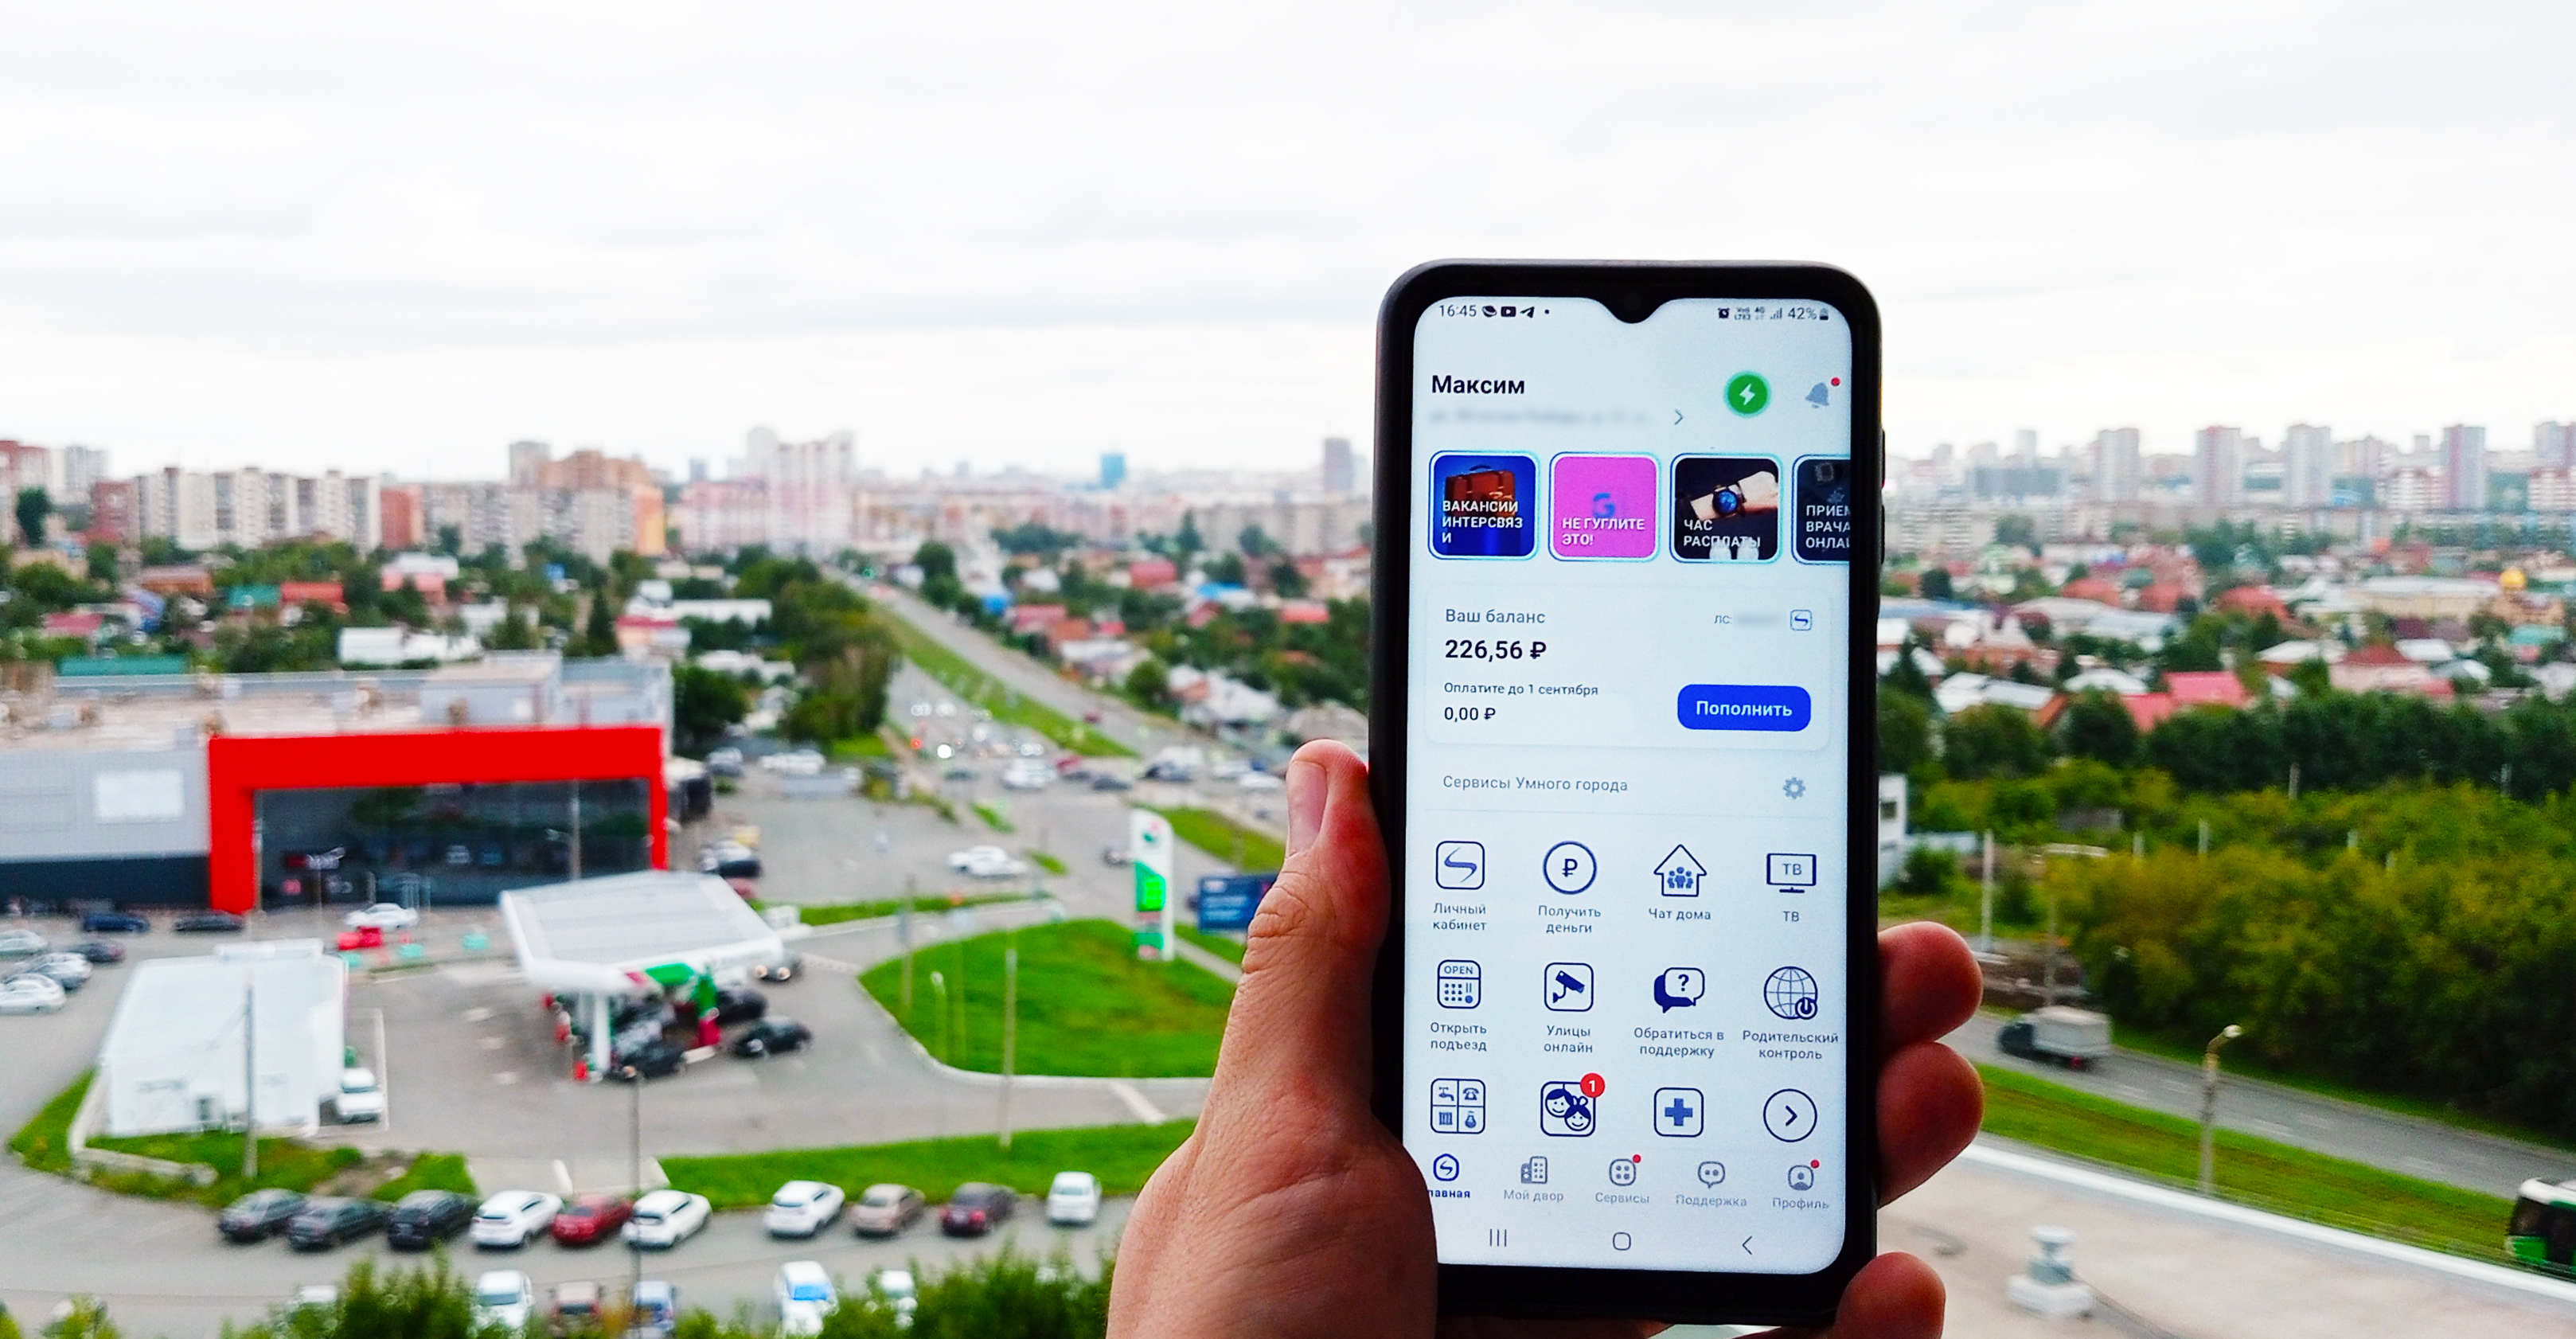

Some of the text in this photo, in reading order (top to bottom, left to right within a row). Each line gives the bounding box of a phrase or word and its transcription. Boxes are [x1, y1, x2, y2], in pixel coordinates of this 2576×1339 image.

[1439, 304, 1477, 318] 16:45
[1787, 306, 1817, 320] 42%
[1431, 374, 1525, 394] Максим
[1442, 500, 1519, 512] ВАКАНСИИ
[1442, 515, 1524, 529] ИНТЕРСВЯЗ
[1562, 517, 1645, 530] НЕ ГУГЛИТЕ
[1684, 517, 1713, 531] ЧАС
[1805, 521, 1851, 533] ВРАЧА
[1442, 532, 1452, 544] И
[1562, 533, 1594, 546] ЭТО!
[1684, 536, 1761, 548] РАСПЛАТЫ
[1446, 608, 1546, 623] Ваш баланс
[1445, 639, 1523, 662] 226,56
[1444, 682, 1598, 697] Оплатите до 1 сентября
[1444, 706, 1479, 723] 0,00
[1696, 700, 1793, 716] Пополнить
[1443, 775, 1628, 794] Сервисы Умного города
[1782, 863, 1802, 876] ТВ
[1433, 902, 1486, 915] Личный
[1538, 904, 1602, 919] Получить
[1649, 908, 1711, 921] Чат дома
[1782, 911, 1800, 923] ТВ
[1433, 919, 1485, 931] кабинет
[1546, 923, 1592, 935] деньги
[1443, 965, 1473, 975] OPEN
[1430, 1021, 1487, 1036] Открыть
[1547, 1025, 1590, 1038] Улицы
[1633, 1026, 1724, 1041] Обратиться в
[1743, 1029, 1839, 1044] Родительский
[1430, 1040, 1487, 1052] подъезд
[1544, 1041, 1593, 1053] онлайн
[1640, 1046, 1715, 1060] поддержку
[1758, 1049, 1823, 1061] контроль
[1588, 1079, 1597, 1094] 1
[1428, 1189, 1470, 1198] лавная
[1504, 1189, 1564, 1204] Мой двор
[1594, 1192, 1649, 1204] Сервисы
[1676, 1194, 1747, 1208] Поддержка
[1772, 1197, 1829, 1211] Профиль
